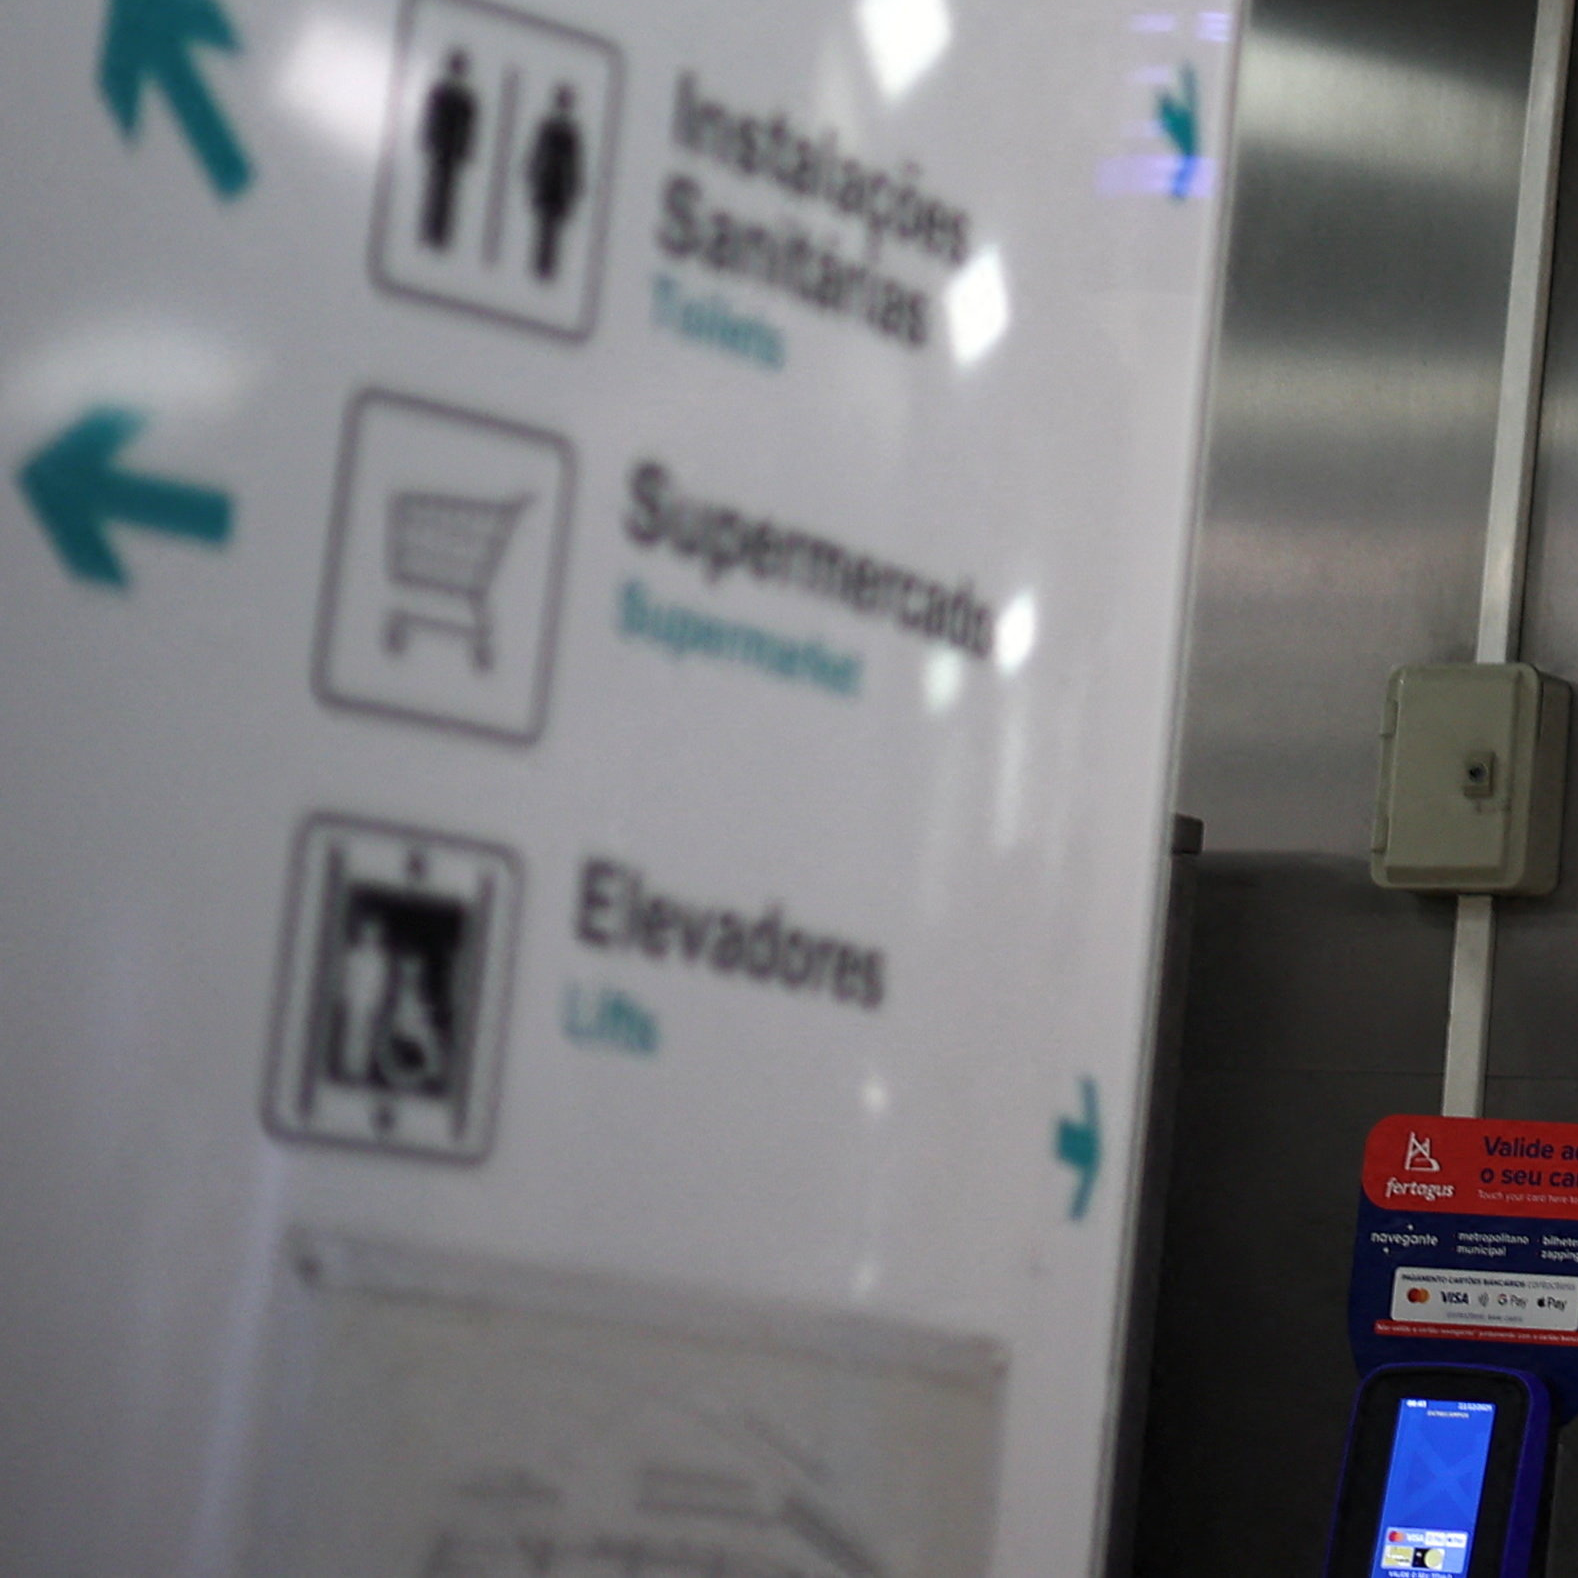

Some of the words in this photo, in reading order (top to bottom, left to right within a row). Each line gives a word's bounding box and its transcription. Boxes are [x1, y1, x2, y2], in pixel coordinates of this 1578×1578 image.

[675, 70, 970, 269] Instalações
[655, 174, 930, 348] Sanitárias
[575, 856, 887, 1012] Elevadores
[1483, 1136, 1554, 1160] Valide
[1480, 1167, 1495, 1184] o
[1501, 1168, 1542, 1186] seu
[1384, 1177, 1455, 1201] fertagus
[1370, 1232, 1439, 1248] navegante
[1457, 1231, 1530, 1246] metropolitano
[1456, 1244, 1507, 1258] municipal
[1440, 1290, 1470, 1306] VISA
[1510, 1294, 1528, 1310] Pay
[1546, 1298, 1568, 1312] Pay
